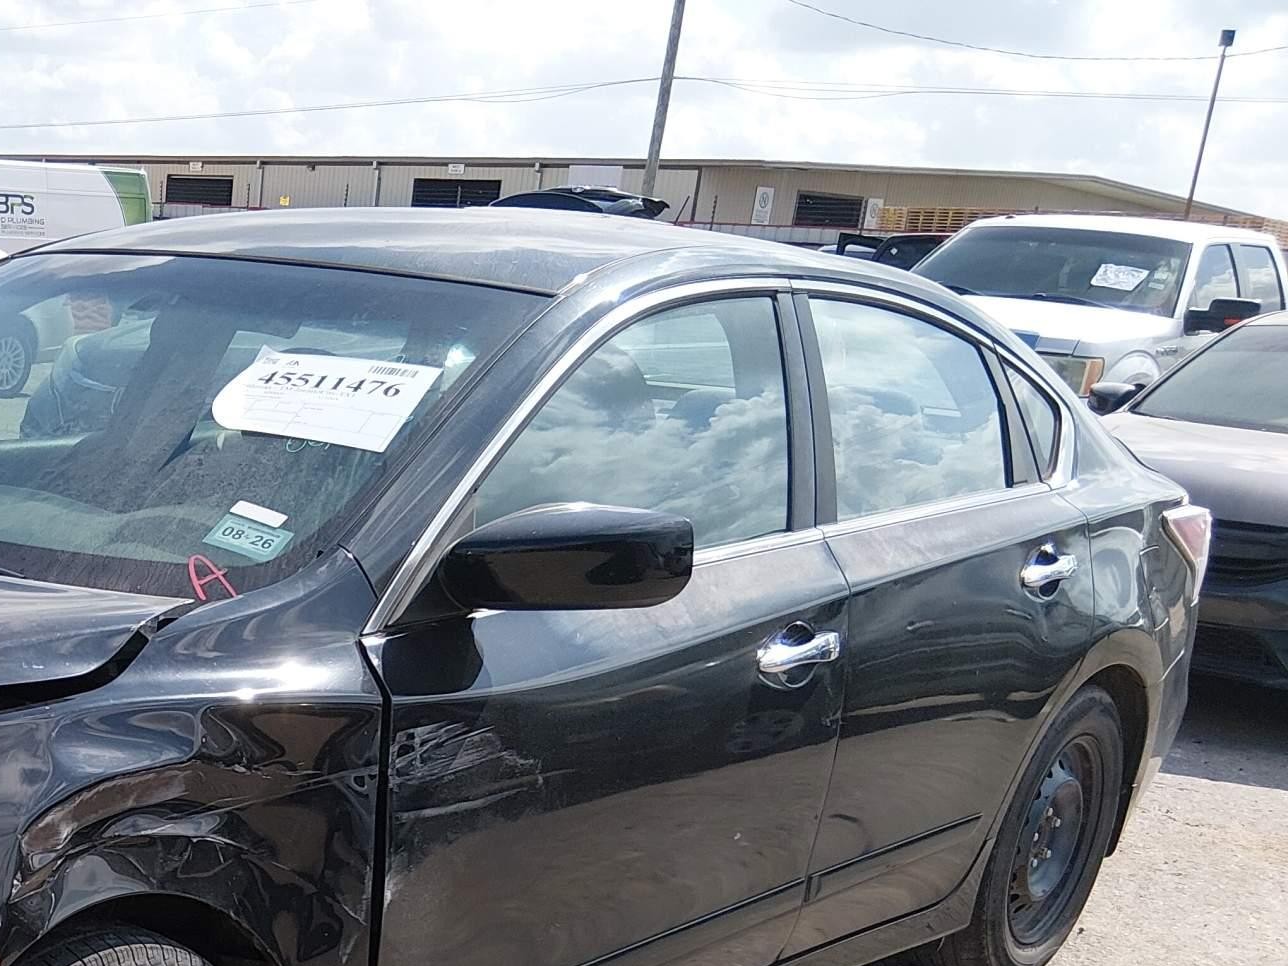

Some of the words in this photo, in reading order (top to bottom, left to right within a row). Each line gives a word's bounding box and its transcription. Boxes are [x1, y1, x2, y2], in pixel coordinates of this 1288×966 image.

[7, 217, 45, 226] PLUMBING
[258, 370, 406, 398] 45511476
[188, 555, 238, 600] A
